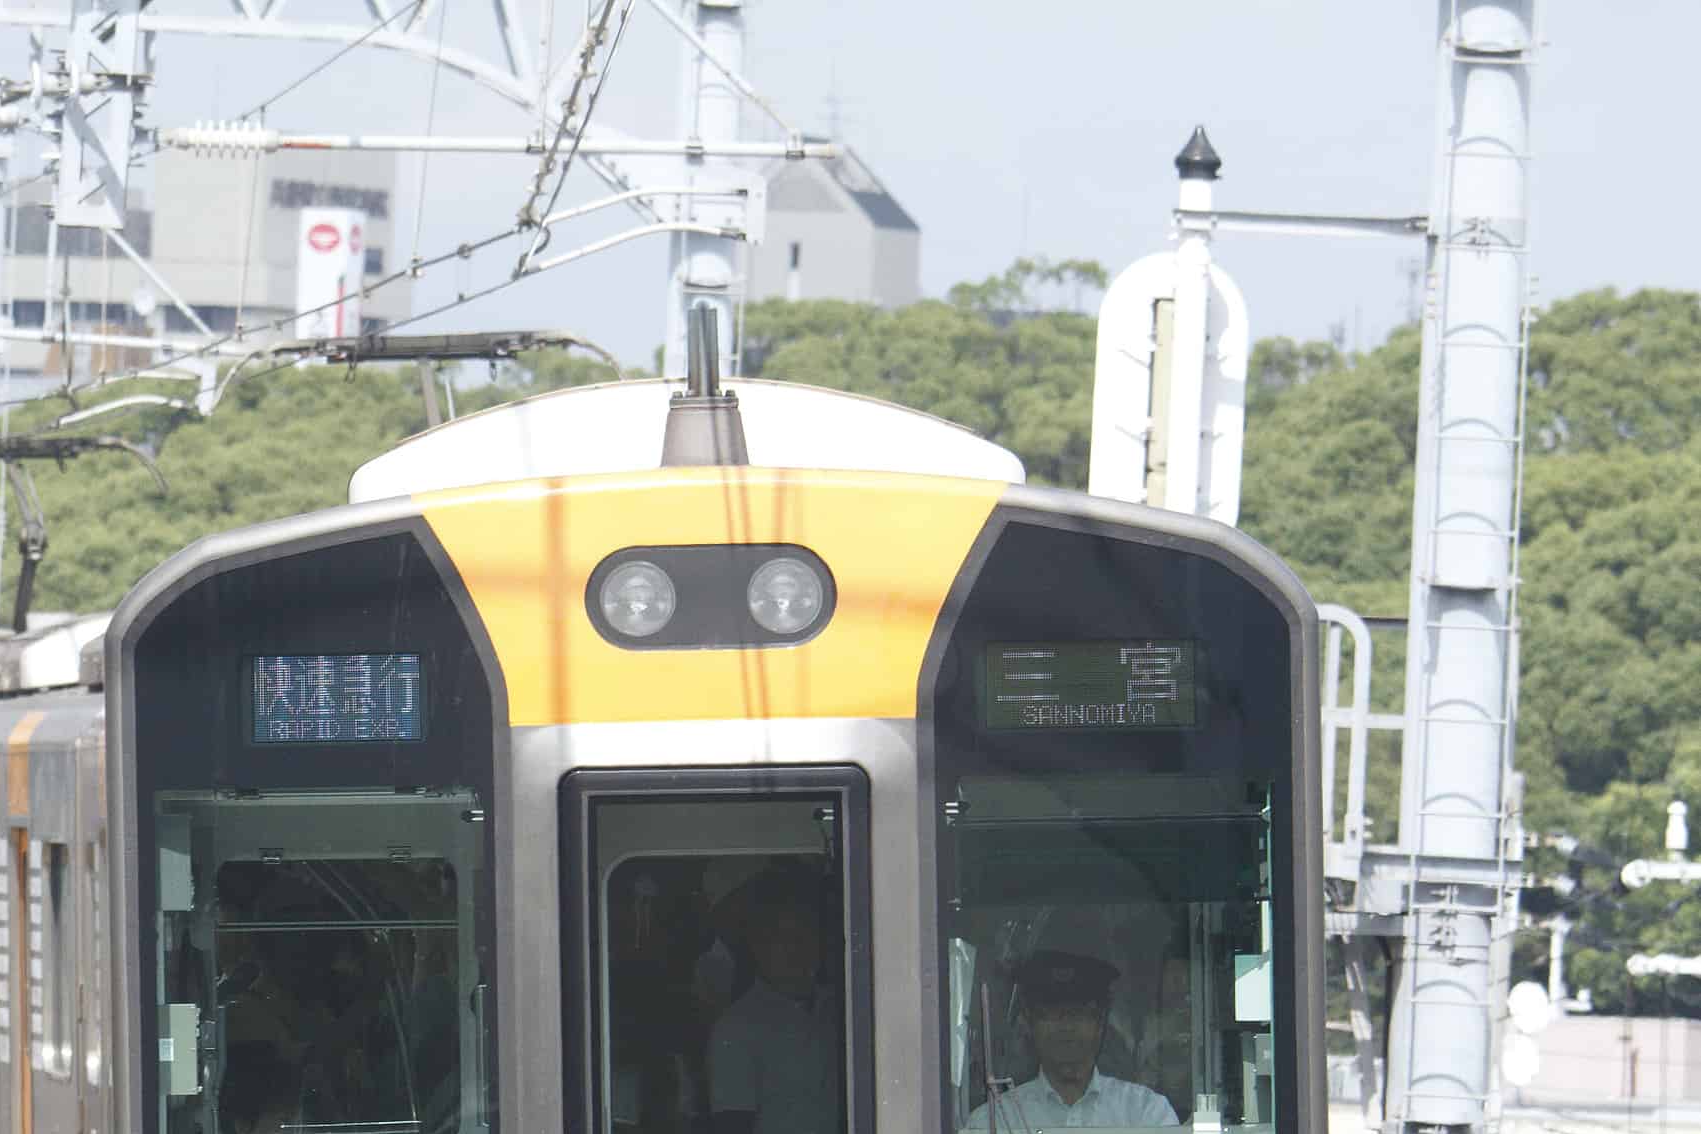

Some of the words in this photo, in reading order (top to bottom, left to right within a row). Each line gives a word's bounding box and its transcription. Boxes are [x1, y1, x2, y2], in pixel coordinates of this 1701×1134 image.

[254, 655, 420, 715] 快速急行
[996, 642, 1181, 702] 三宮
[269, 719, 340, 738] RAPID
[1022, 703, 1156, 725] SANNOMIYA
